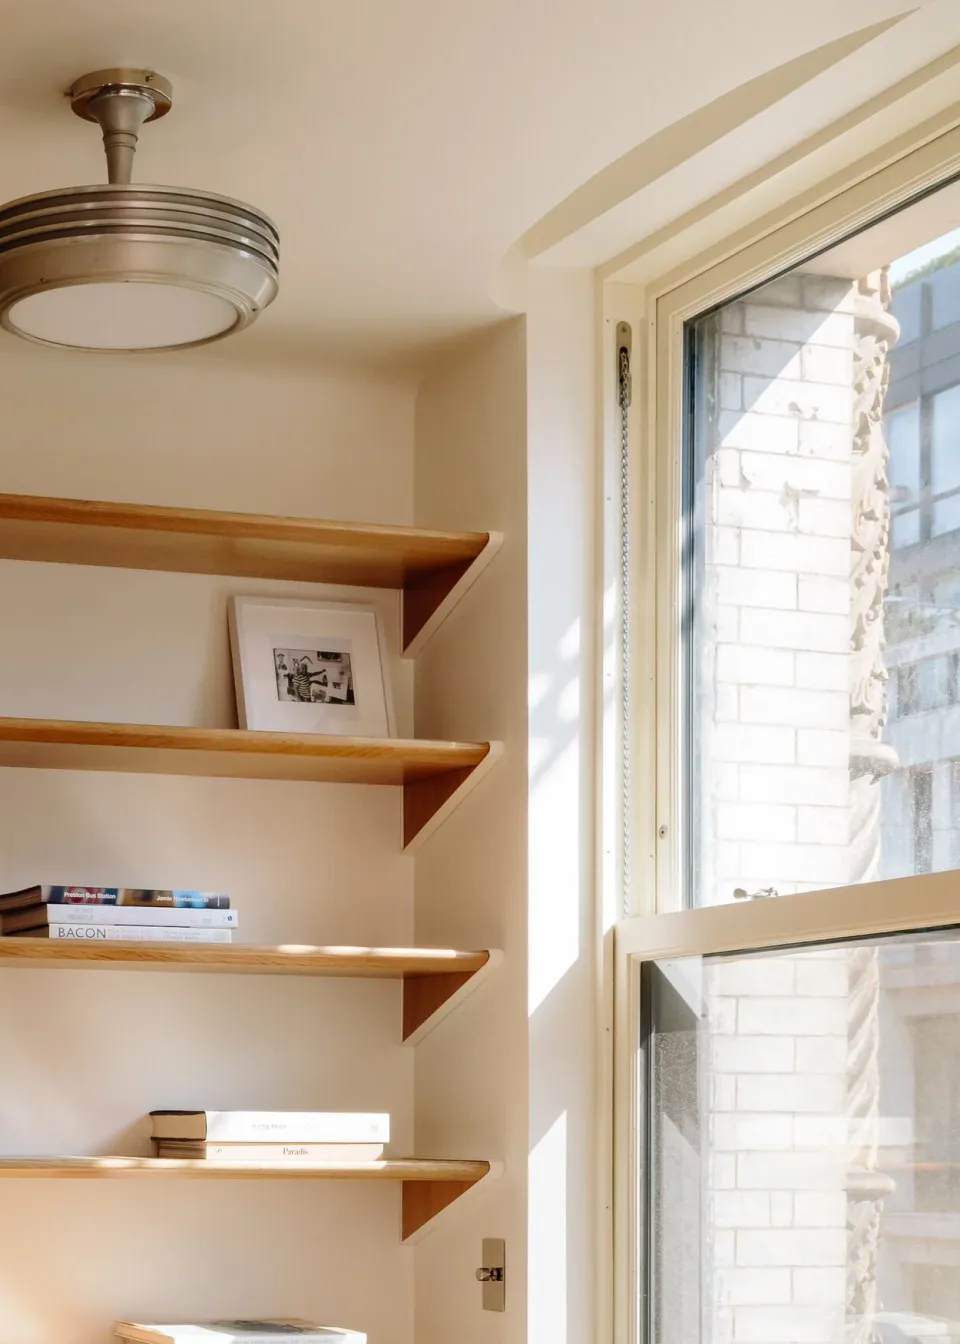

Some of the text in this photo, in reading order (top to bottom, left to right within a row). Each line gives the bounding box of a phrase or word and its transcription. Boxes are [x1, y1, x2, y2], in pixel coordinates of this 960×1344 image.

[63, 891, 85, 899] Preston
[57, 927, 106, 938] BACON
[283, 1147, 308, 1156] Paradis
